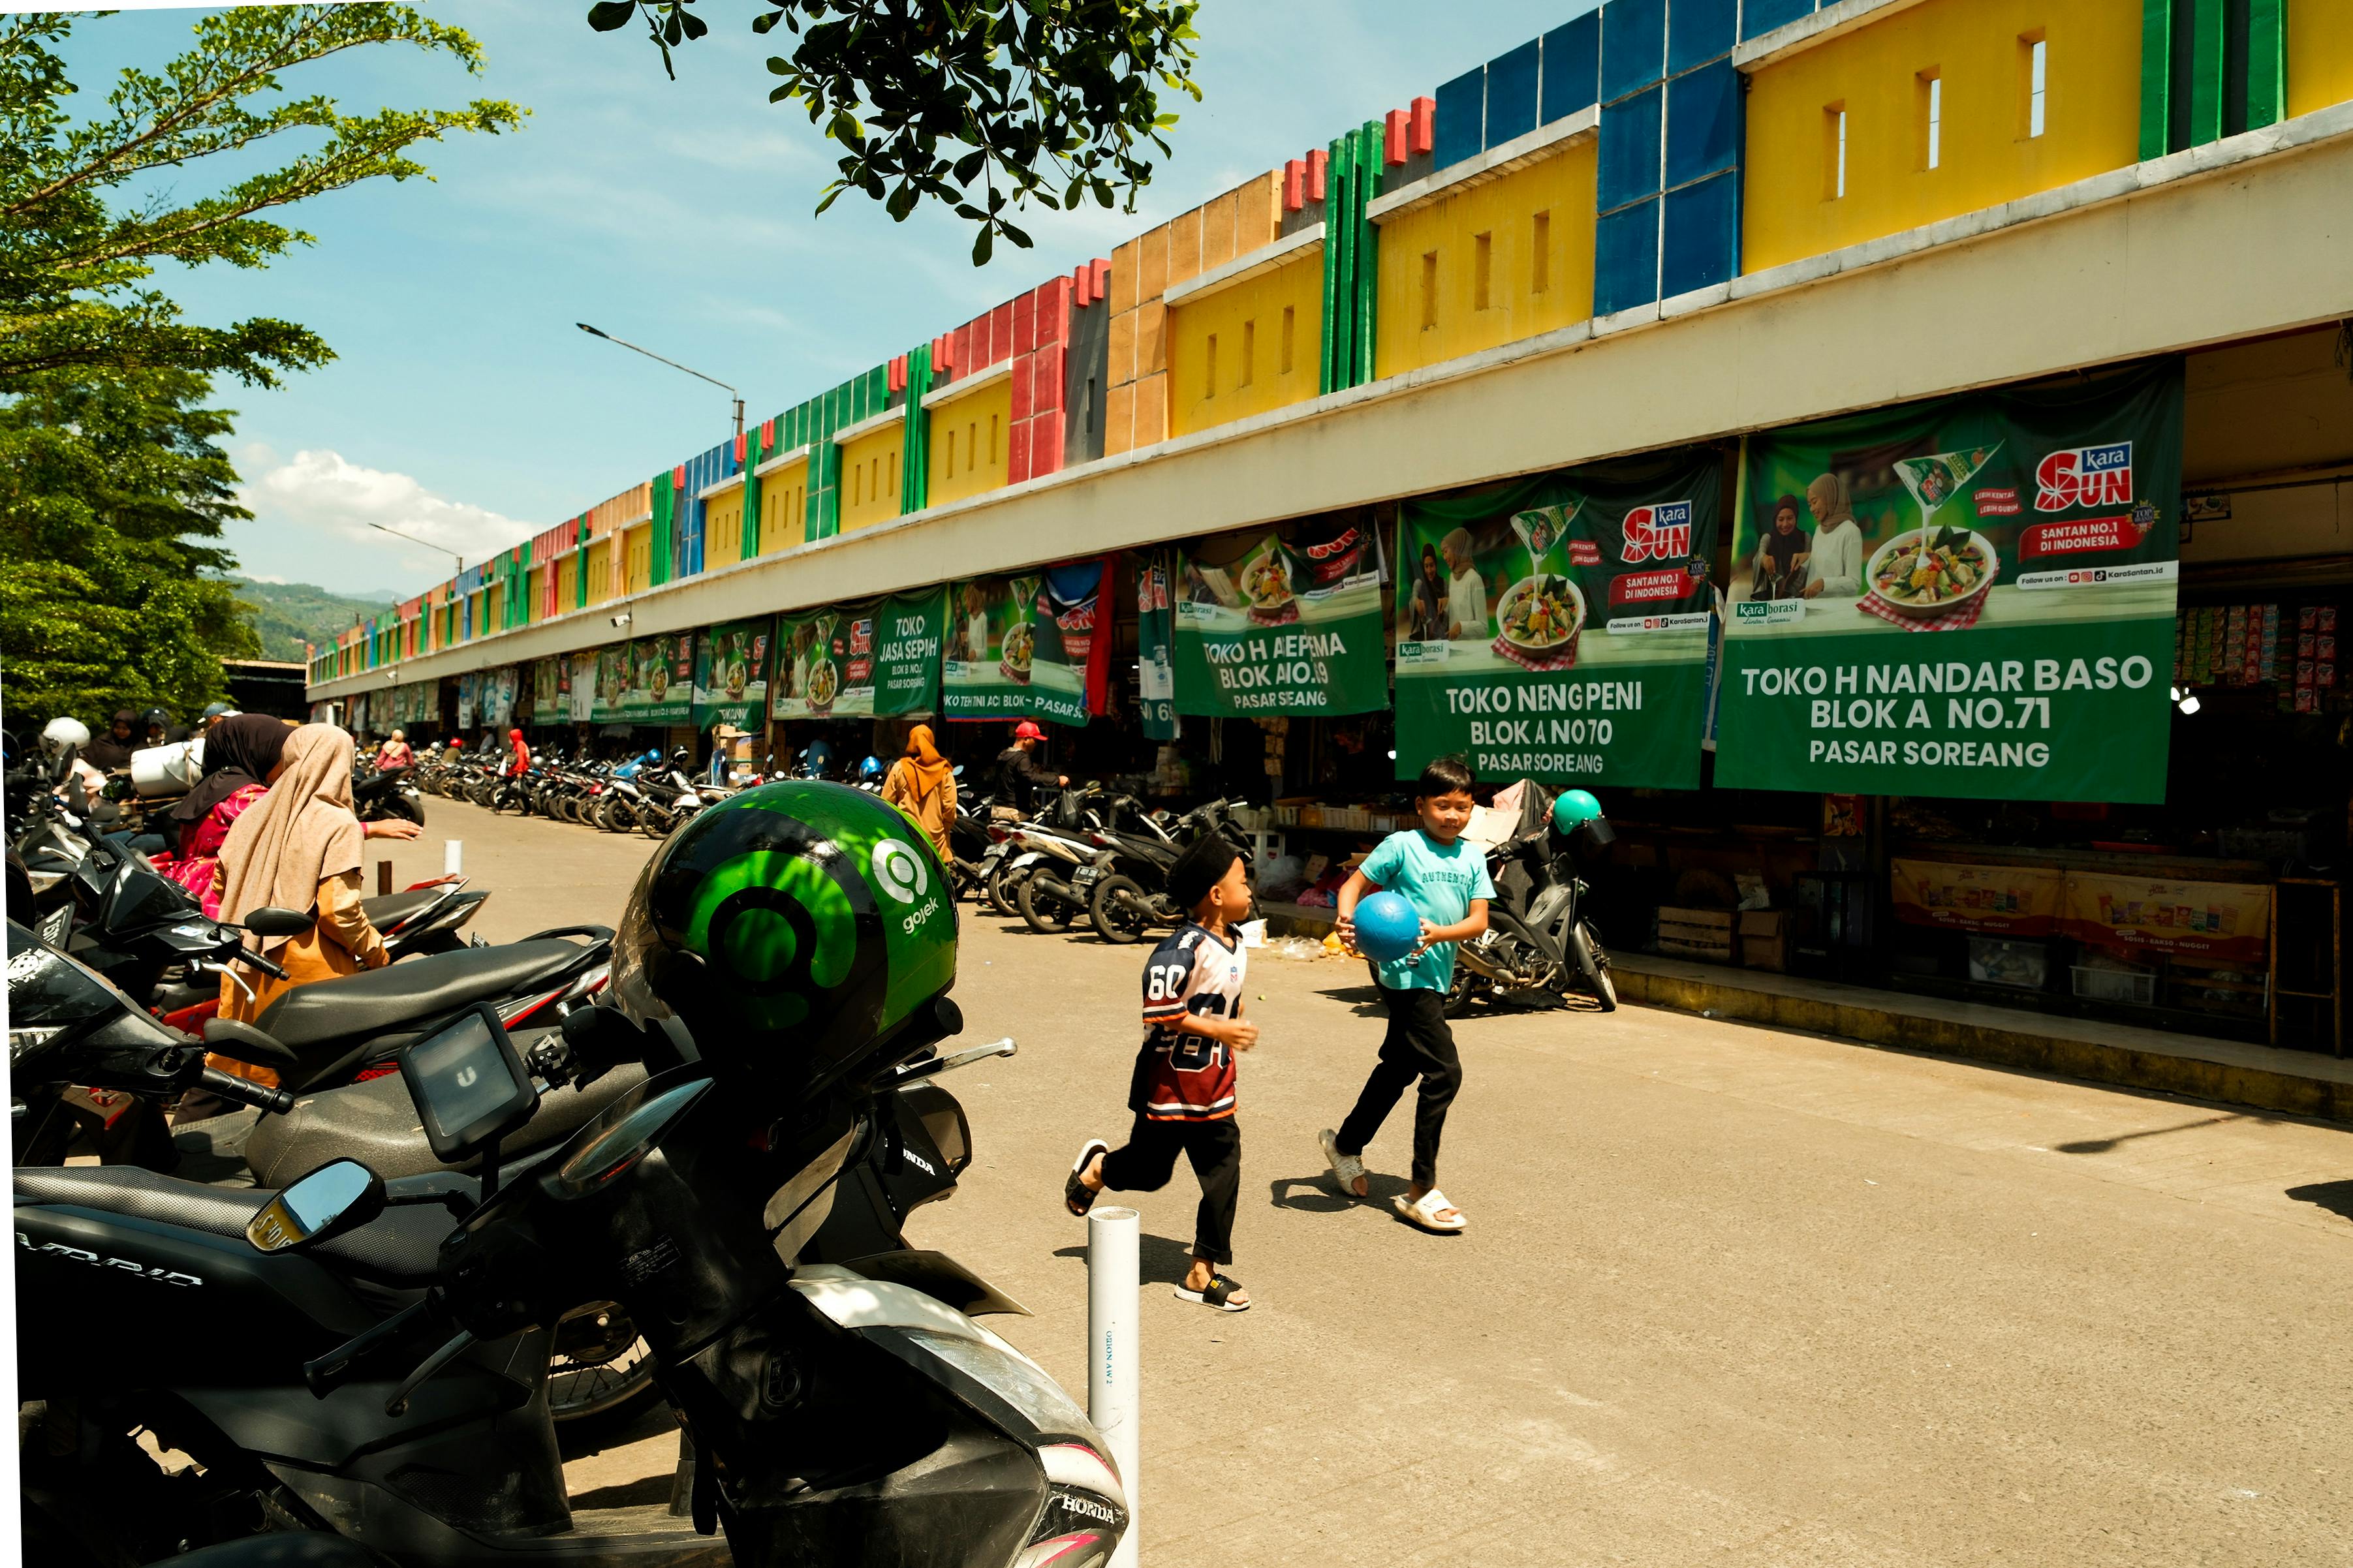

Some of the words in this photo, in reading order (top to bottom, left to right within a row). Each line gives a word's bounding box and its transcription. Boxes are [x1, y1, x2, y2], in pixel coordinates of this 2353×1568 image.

[2087, 450, 2125, 469] kara
[2034, 451, 2132, 512] SUN
[1991, 491, 2015, 499] KENTAL
[1659, 507, 1686, 525] kara
[1980, 505, 1997, 514] LEBIH
[1999, 504, 2018, 512] GURIH
[1621, 507, 1691, 563] SUN
[2042, 526, 2087, 539] SANTAN
[2090, 522, 2118, 534] NO.1
[2041, 541, 2051, 551] DI
[2054, 535, 2119, 550] INDONESIA
[1626, 576, 1659, 587] SANTAN
[1660, 574, 1679, 585] NO.1
[2108, 567, 2164, 579] KaraSantan.id
[1625, 590, 1633, 599] DI
[1634, 585, 1678, 598] INDONESIA
[896, 615, 925, 638] TOKO
[880, 641, 904, 662] JASA
[1202, 642, 1245, 664] TOKO
[1248, 639, 1268, 662] H
[892, 664, 904, 675] BLOK
[1219, 664, 1272, 688] BLOK
[1741, 667, 1827, 696] TOKO
[1835, 666, 1859, 695] H
[1866, 661, 2024, 694] NANDAR
[2034, 656, 2153, 692] BASO
[887, 679, 903, 690] PASAR
[1003, 695, 1025, 707] BLOK
[1034, 696, 1074, 716] PASAR
[1234, 692, 1277, 709] PASAR
[1446, 686, 1512, 714] TOKO
[1518, 683, 1583, 712] NENG
[1587, 681, 1643, 711] PENI
[1811, 699, 1897, 729] BLOK
[1905, 699, 1932, 729] A
[1948, 697, 2050, 729] NO.71
[1471, 720, 1531, 745] BLOK
[1535, 721, 1546, 745] A
[1478, 753, 1532, 772] PASAR
[1534, 754, 1603, 774] SOREANG
[1809, 741, 1897, 764] PASAR
[1903, 742, 2049, 767] SOREANG
[903, 897, 939, 934] gojek
[2179, 941, 2210, 950] NUGGET
[1148, 964, 1187, 1001] 60
[1061, 1495, 1115, 1525] HONDA
